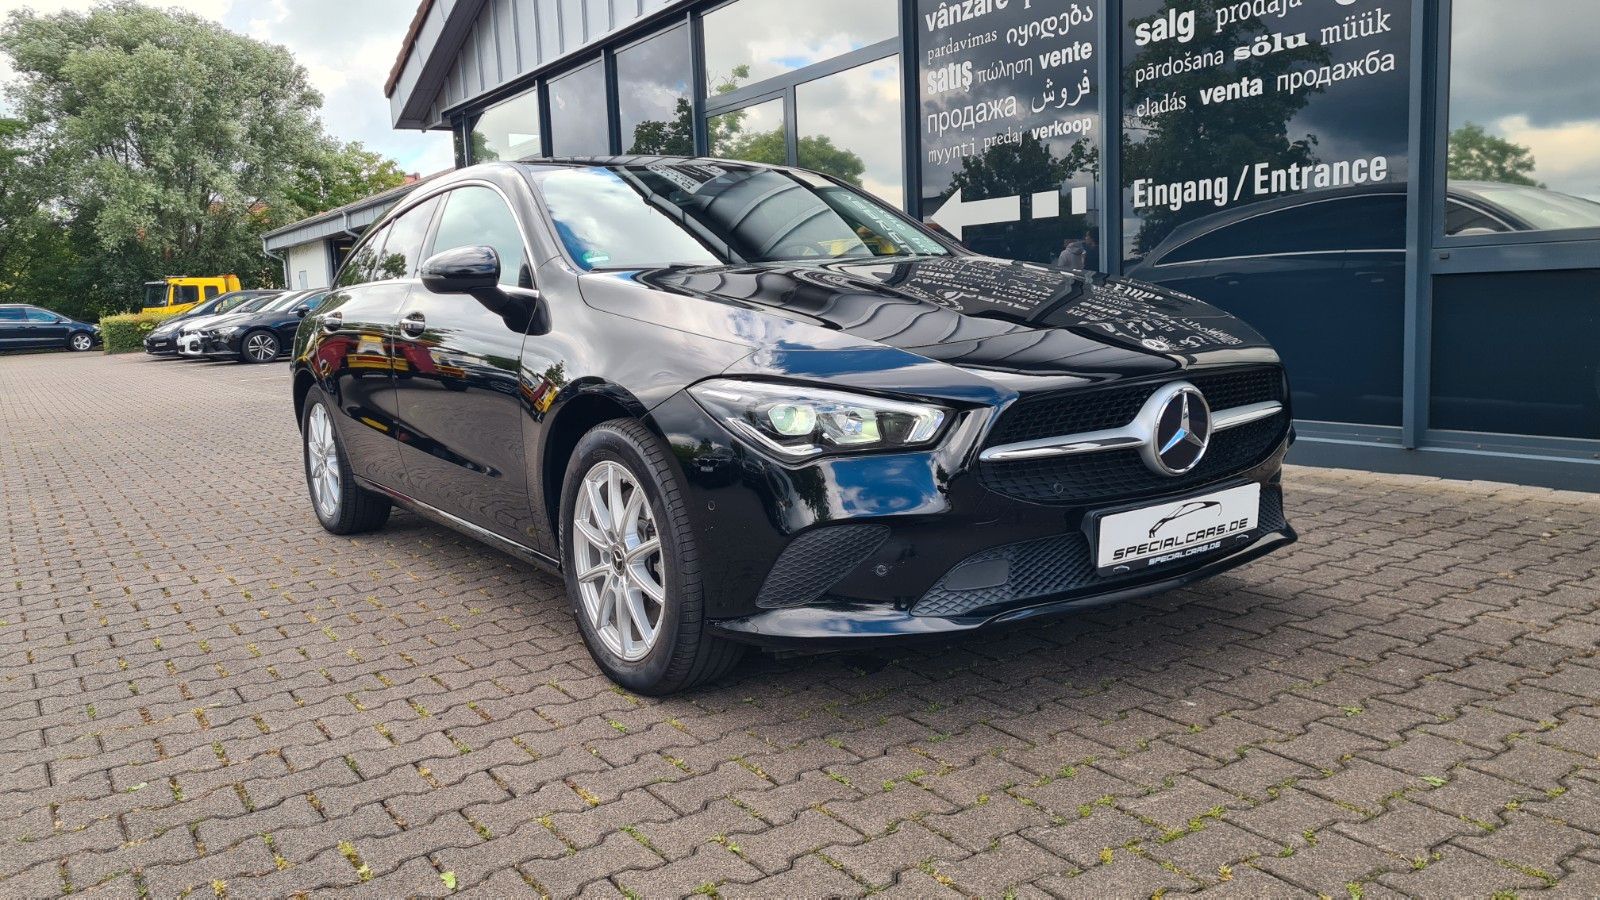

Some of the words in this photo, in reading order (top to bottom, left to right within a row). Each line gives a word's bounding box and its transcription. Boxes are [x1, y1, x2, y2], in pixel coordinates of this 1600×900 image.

[928, 30, 998, 65] pardavimas
[1007, 4, 1093, 46] იყიდება
[1135, 8, 1194, 46] salg
[1136, 50, 1224, 87] pārdošana
[1234, 33, 1309, 61] sölu
[1321, 8, 1391, 45] müük
[927, 60, 973, 95] satış
[977, 58, 1033, 83] πώληση
[1039, 41, 1092, 70] vente
[1136, 91, 1187, 118] eladás
[1200, 77, 1263, 105] venta
[1277, 50, 1395, 95] продажба
[928, 96, 1017, 137] продажа
[1031, 69, 1090, 114] فروش
[928, 139, 975, 165] myynti
[983, 125, 1024, 153] predaj
[1032, 117, 1092, 140] verkoop
[1134, 177, 1227, 211] Eingang
[1254, 156, 1388, 195] Entrance
[1113, 517, 1249, 560] SPECIALCARS.DE
[1148, 541, 1222, 566] SPECIALCARS.DE
